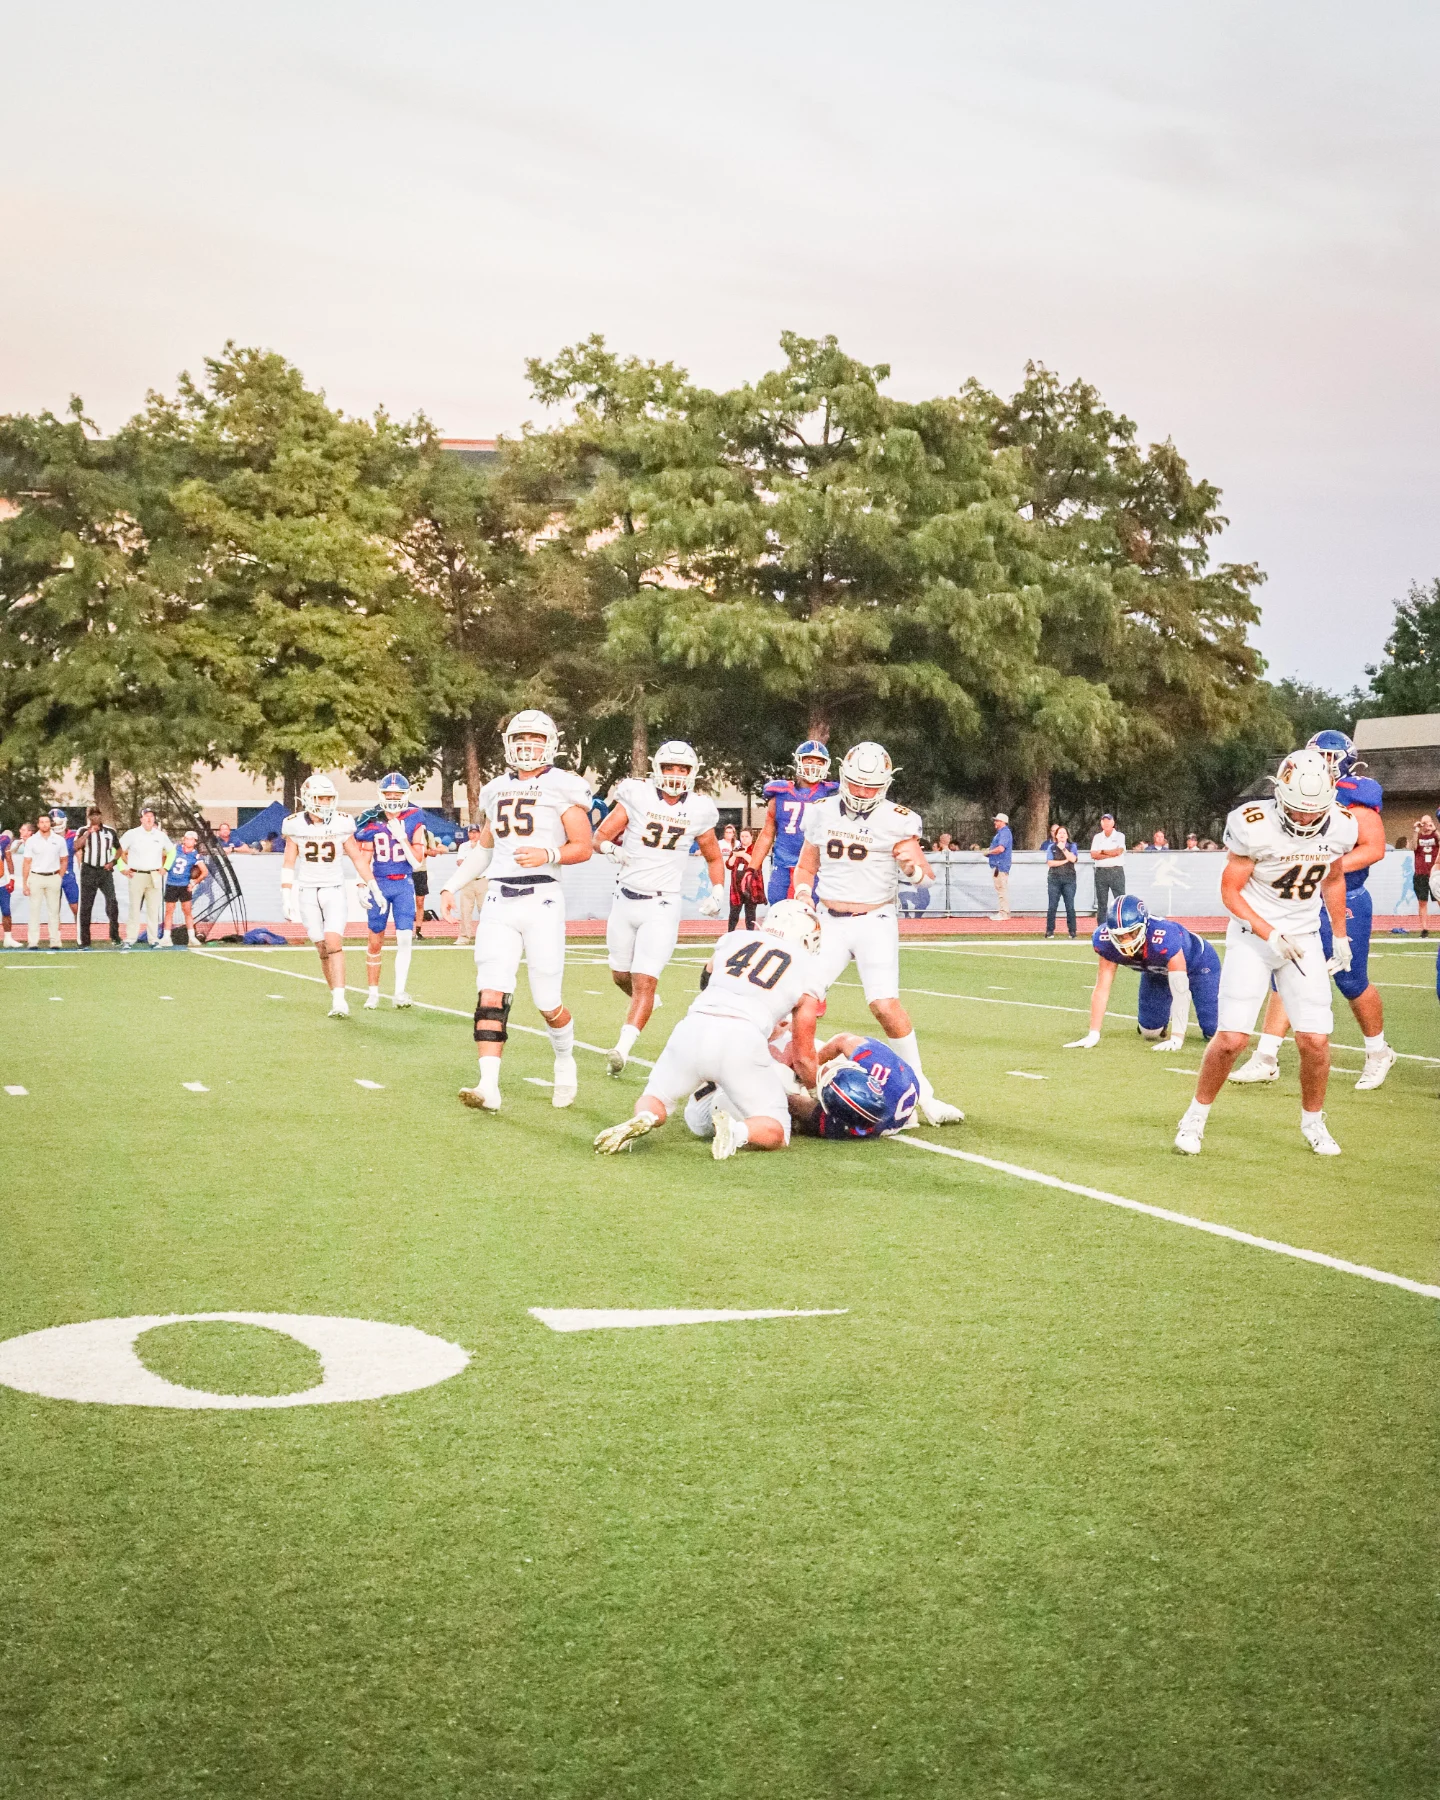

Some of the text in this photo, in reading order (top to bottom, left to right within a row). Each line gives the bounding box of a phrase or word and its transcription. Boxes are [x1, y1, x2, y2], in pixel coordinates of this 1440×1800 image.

[497, 790, 543, 798] PRESTONWOOD
[494, 797, 537, 839] 55
[646, 811, 691, 826] PRESTONWOOD
[783, 800, 803, 834] 7
[641, 821, 686, 851] 37
[827, 829, 874, 844] PRESTONWOOD
[304, 841, 336, 863] 23
[1280, 854, 1331, 862] PRESTONWOO
[172, 857, 188, 875] 3
[1270, 863, 1327, 900] 48
[1151, 929, 1167, 945] 58
[725, 941, 792, 990] 40
